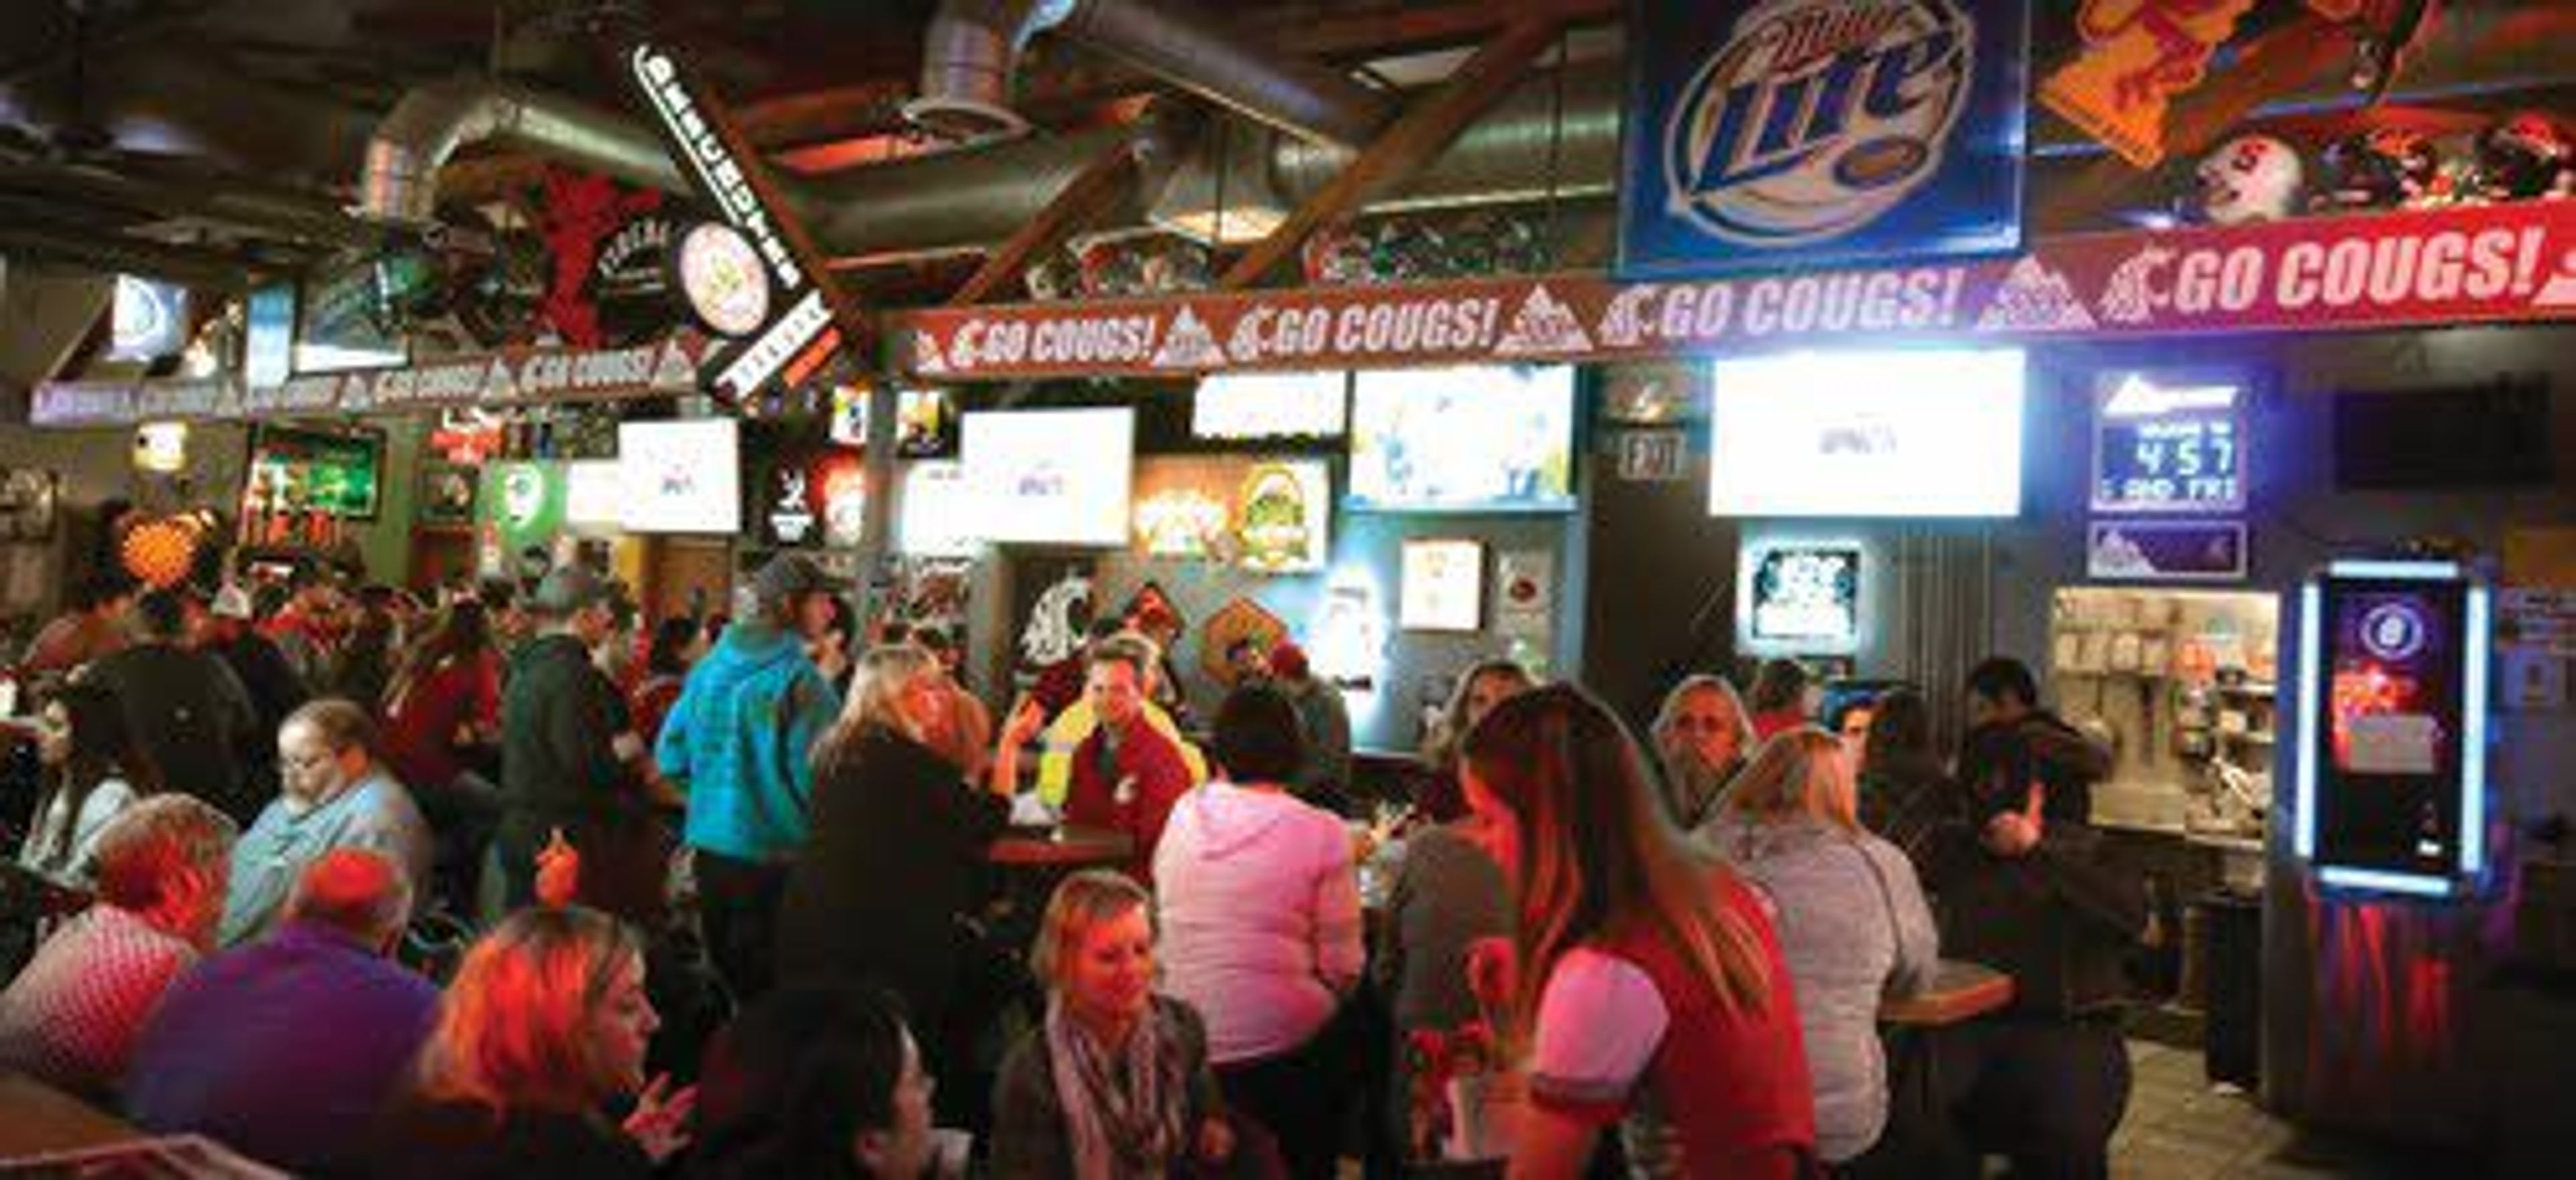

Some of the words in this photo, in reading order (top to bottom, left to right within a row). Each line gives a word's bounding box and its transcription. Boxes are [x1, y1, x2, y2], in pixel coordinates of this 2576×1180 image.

[2175, 246, 2263, 314] GO
[2277, 227, 2546, 307] COUGS!
[1275, 306, 1330, 354] GO
[1335, 298, 1500, 352] COUGS!
[1661, 284, 1732, 337] GO
[1744, 268, 1964, 333] COUGS!
[984, 321, 1029, 362] GO
[1032, 315, 1155, 362] COUGS!
